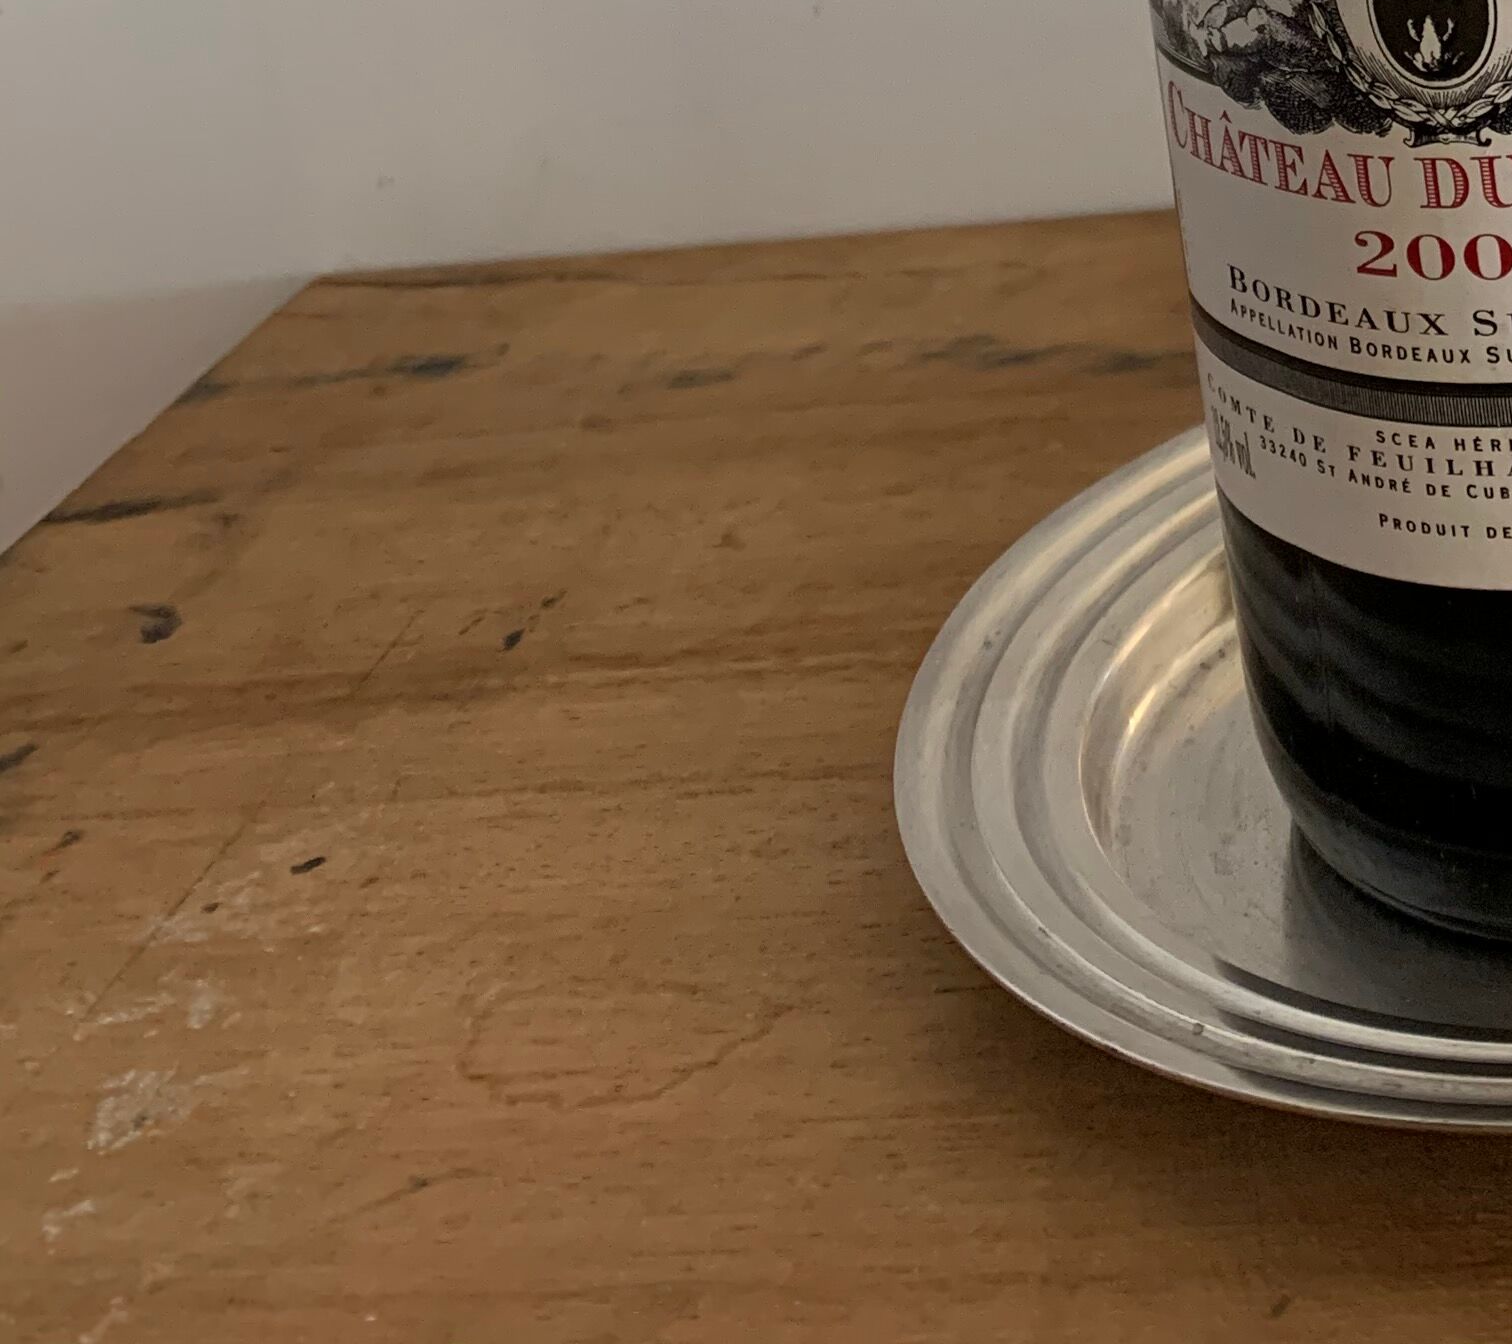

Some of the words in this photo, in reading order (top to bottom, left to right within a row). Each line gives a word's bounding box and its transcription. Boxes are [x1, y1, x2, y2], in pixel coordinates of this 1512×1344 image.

[1168, 80, 1395, 208] CHÂTEAU
[1227, 263, 1449, 336] BORDEAUX
[1230, 297, 1338, 350] APPELLATION
[1349, 336, 1471, 364] BORDEAUX
[1207, 373, 1275, 434] COMTE
[1293, 426, 1327, 454] DE
[1376, 430, 1436, 450] SCEA
[1260, 434, 1307, 467] 33240
[1348, 468, 1413, 493] ANDRÉ
[1426, 483, 1451, 497] DE
[1378, 513, 1470, 538] PRODUIT
[1486, 526, 1512, 539] DE
